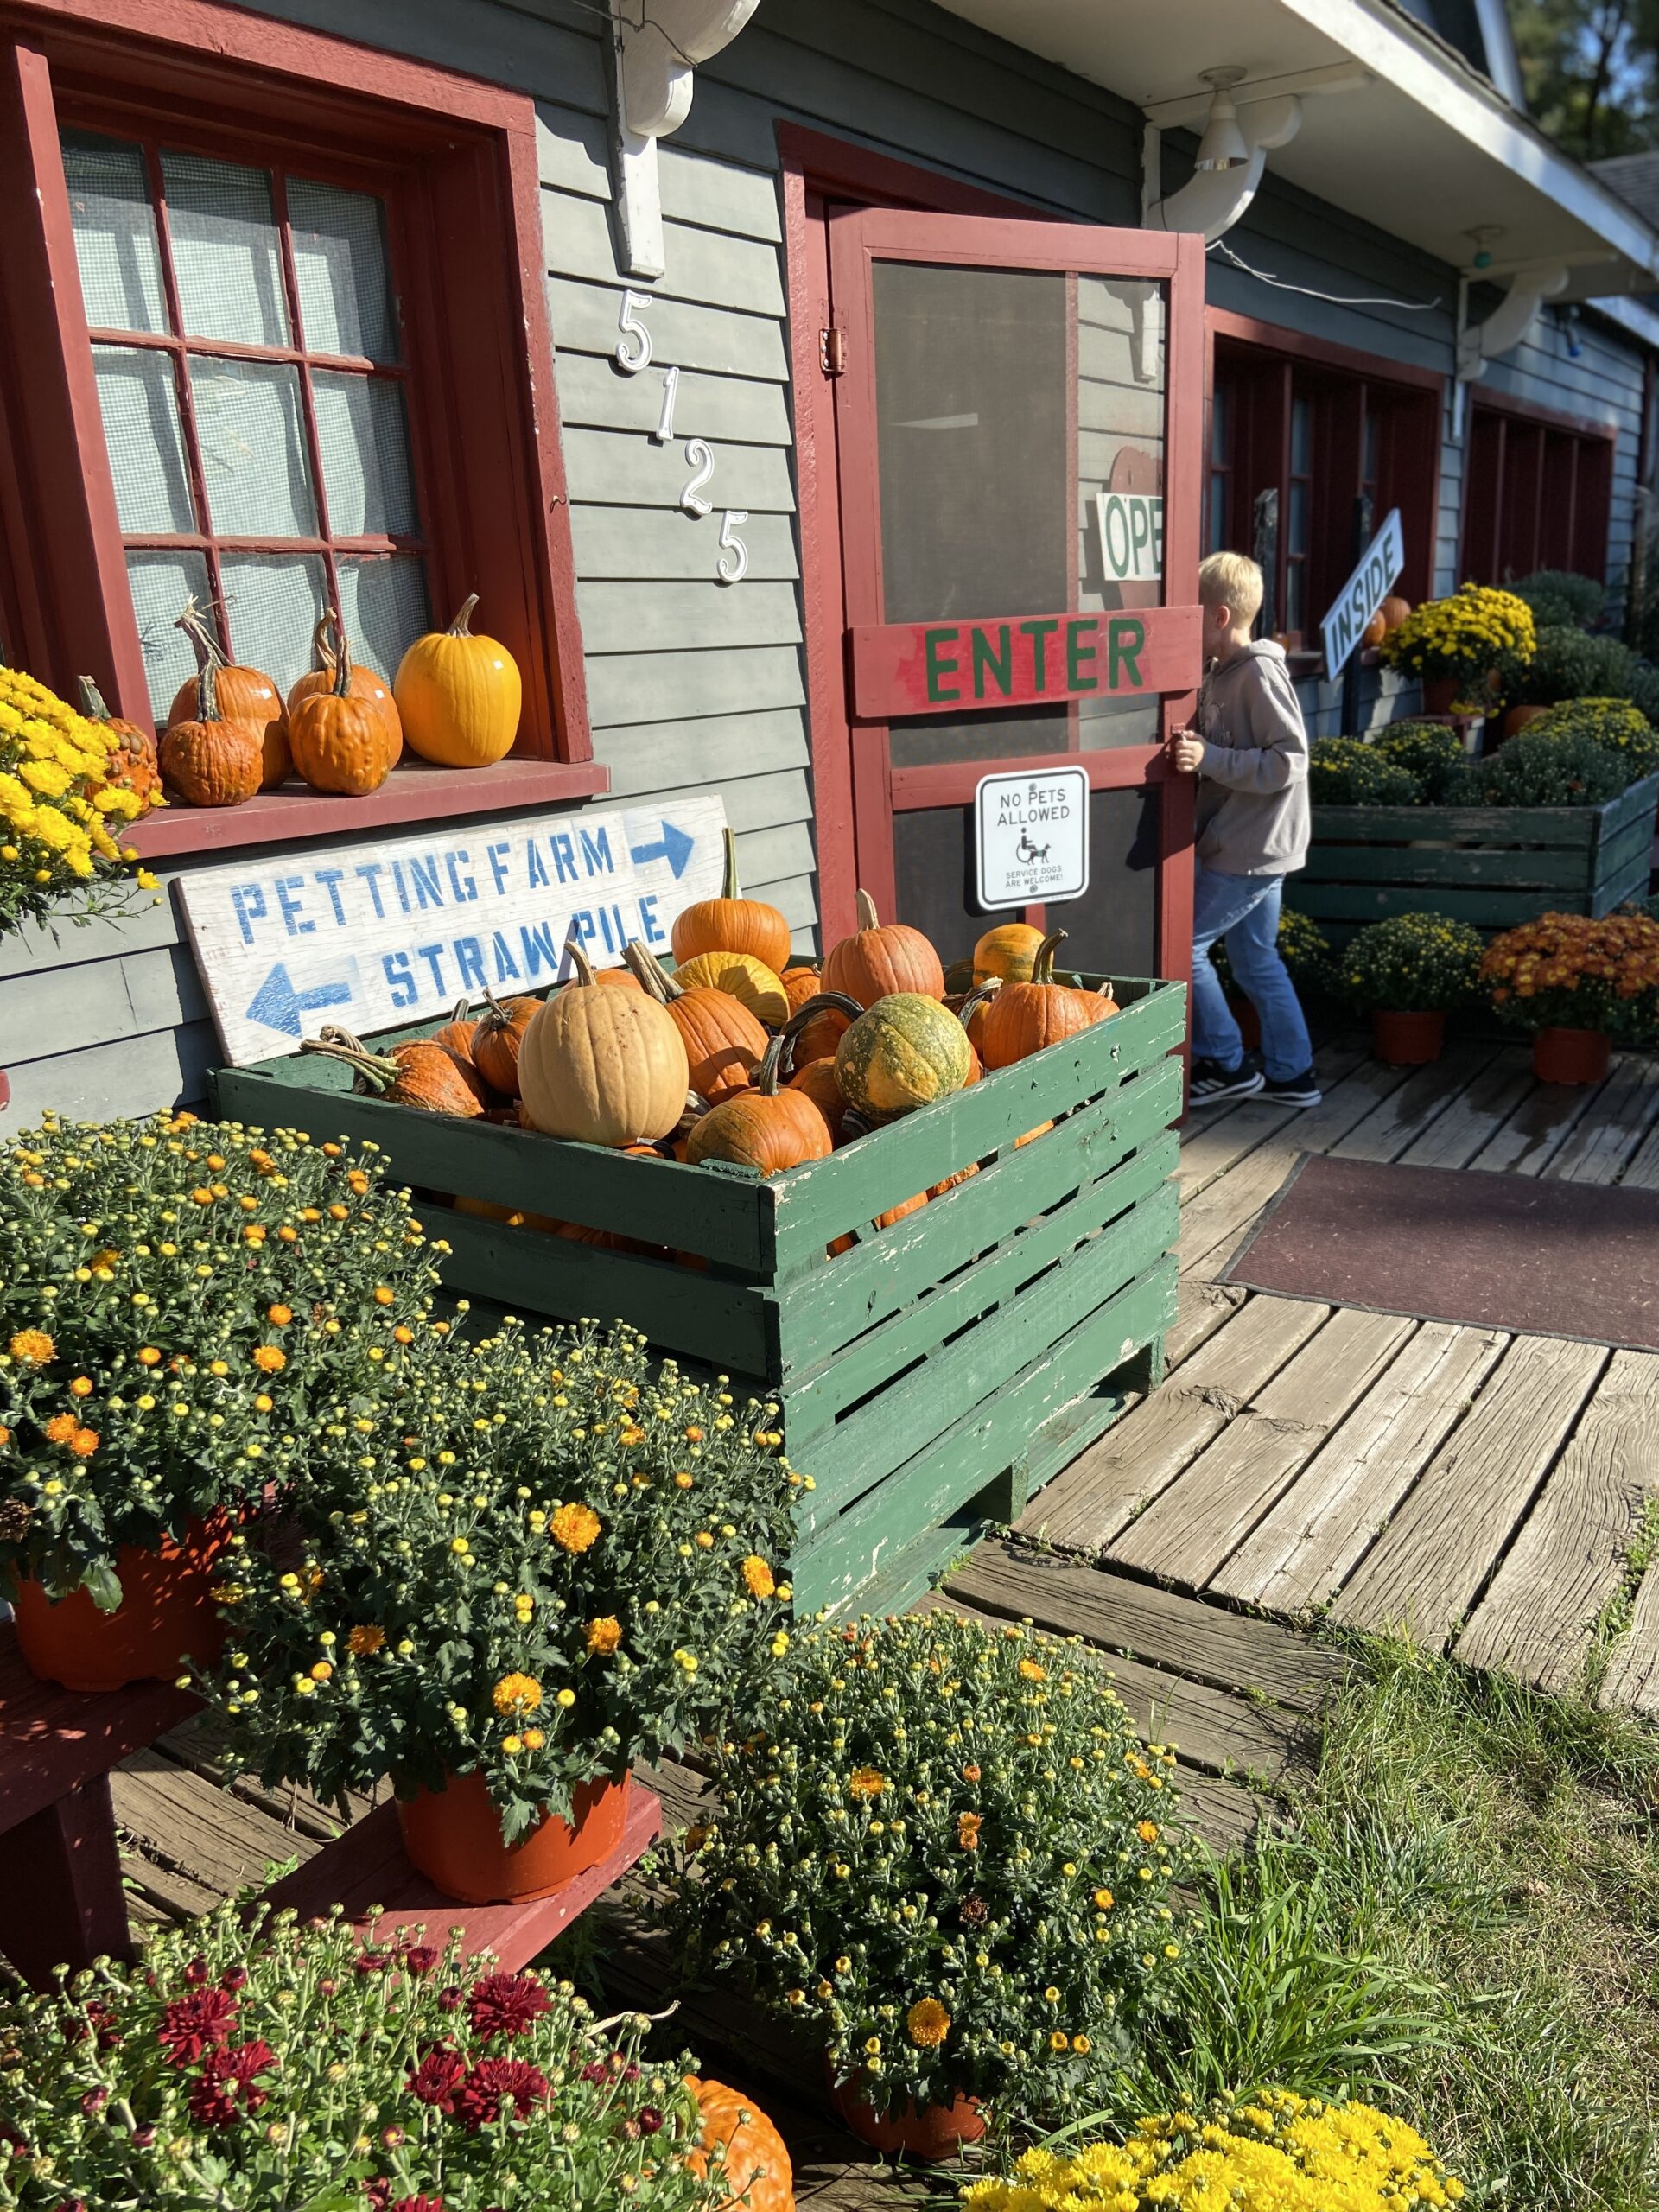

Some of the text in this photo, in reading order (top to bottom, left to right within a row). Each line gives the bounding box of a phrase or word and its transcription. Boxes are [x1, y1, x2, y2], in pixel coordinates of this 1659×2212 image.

[1331, 531, 1395, 669] INSIDE
[925, 619, 1146, 703] ENTER
[997, 805, 1070, 827] ALLOWED
[1001, 788, 1066, 809] NO PETS
[232, 827, 614, 944] PETTING FARM
[1005, 865, 1062, 880] SERVICE DOGS
[1005, 874, 1063, 888] ARE WELCOME!
[383, 895, 666, 1008] STRAW PILE
